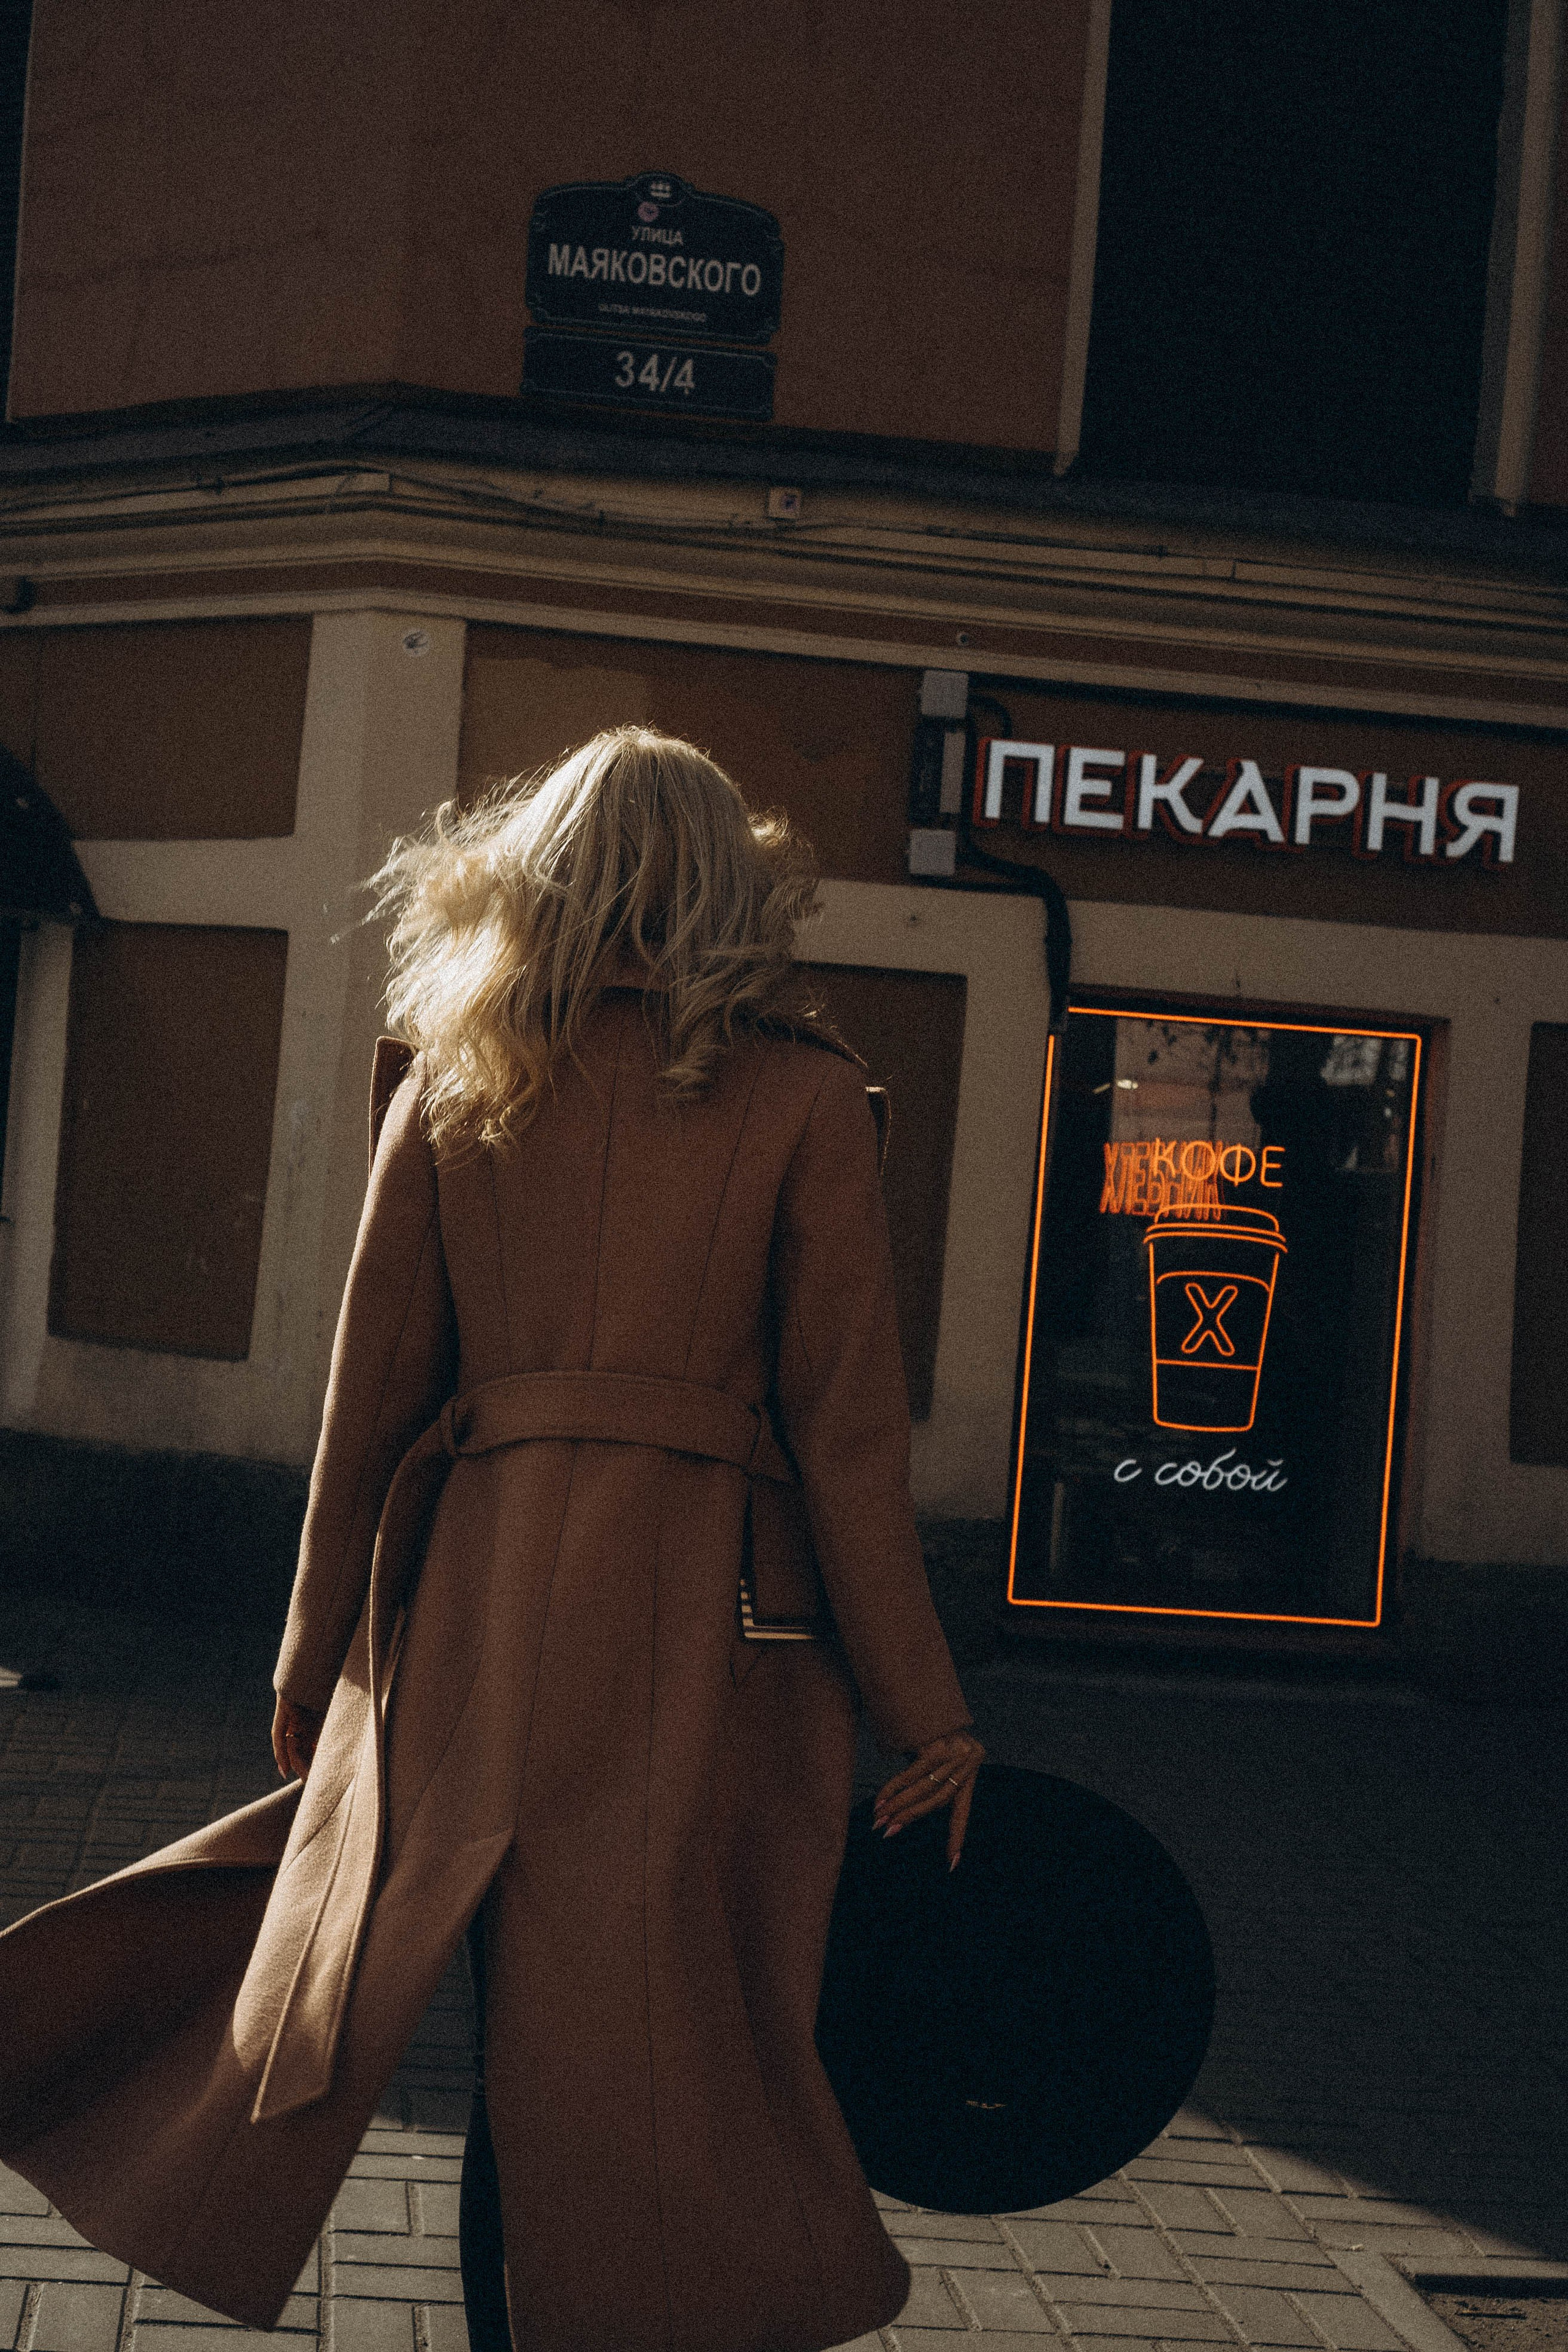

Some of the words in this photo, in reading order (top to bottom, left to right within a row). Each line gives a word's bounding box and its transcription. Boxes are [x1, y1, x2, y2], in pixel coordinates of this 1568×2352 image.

[631, 225, 684, 246] УЛИЦА
[548, 243, 761, 296] МАЯКОВСКОГО
[615, 350, 696, 395] 34/4
[984, 739, 1520, 863] ПЕКАРНЯ
[1153, 1137, 1286, 1188] КОФЕ
[1113, 1456, 1144, 1483] с
[1154, 1446, 1288, 1492] собой
